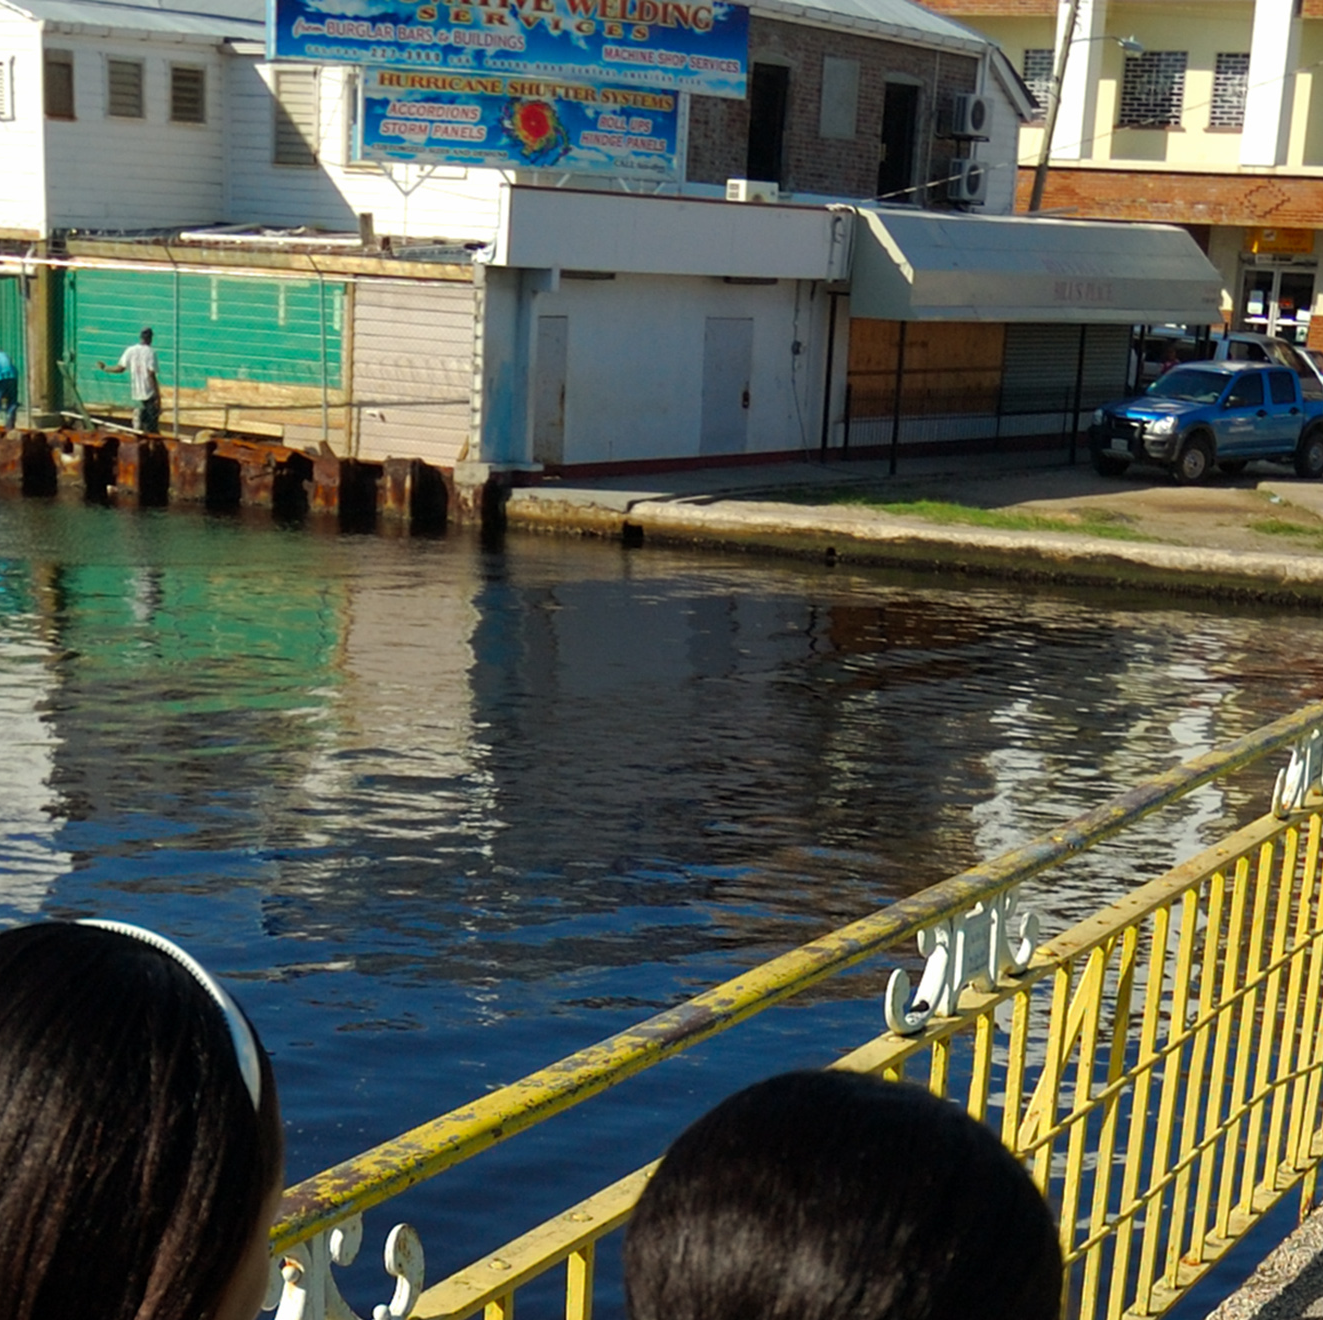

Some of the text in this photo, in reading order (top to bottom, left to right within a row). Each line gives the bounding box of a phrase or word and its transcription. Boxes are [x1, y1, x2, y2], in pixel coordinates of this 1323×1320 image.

[418, 5, 648, 40] SERVICES
[564, 0, 714, 32] WELDING
[293, 17, 323, 38] from
[326, 21, 392, 39] BURGLAR
[398, 26, 433, 42] BARS
[453, 29, 525, 51] BUILDINGS
[603, 46, 740, 73] MACHINE SHOP SERVICES
[378, 72, 673, 112] HURRICANE SHUTTER SYSTEMS
[387, 102, 480, 121] ACCORDIONS
[599, 114, 651, 133] ROLL UPS
[380, 120, 486, 141] STORM PANELS
[580, 131, 667, 152] HINDGE PANELS
